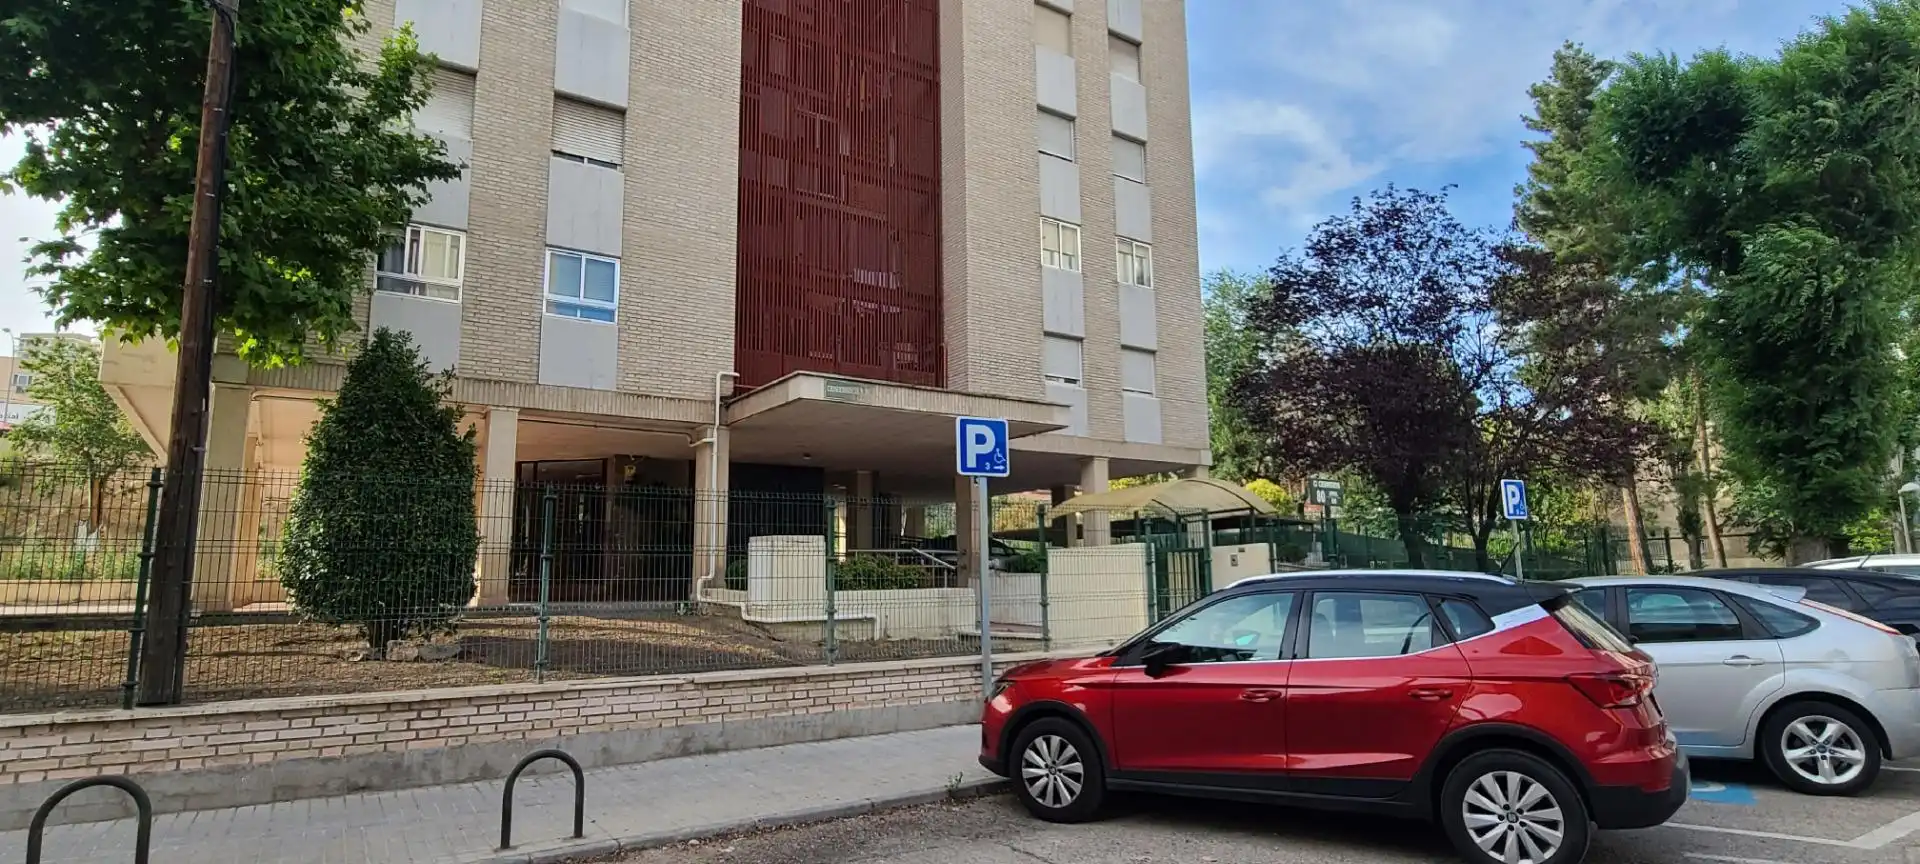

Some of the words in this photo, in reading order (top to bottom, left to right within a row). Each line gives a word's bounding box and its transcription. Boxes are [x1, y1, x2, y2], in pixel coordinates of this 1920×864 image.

[966, 424, 996, 468] P
[985, 462, 991, 471] 3
[1506, 484, 1520, 514] P
